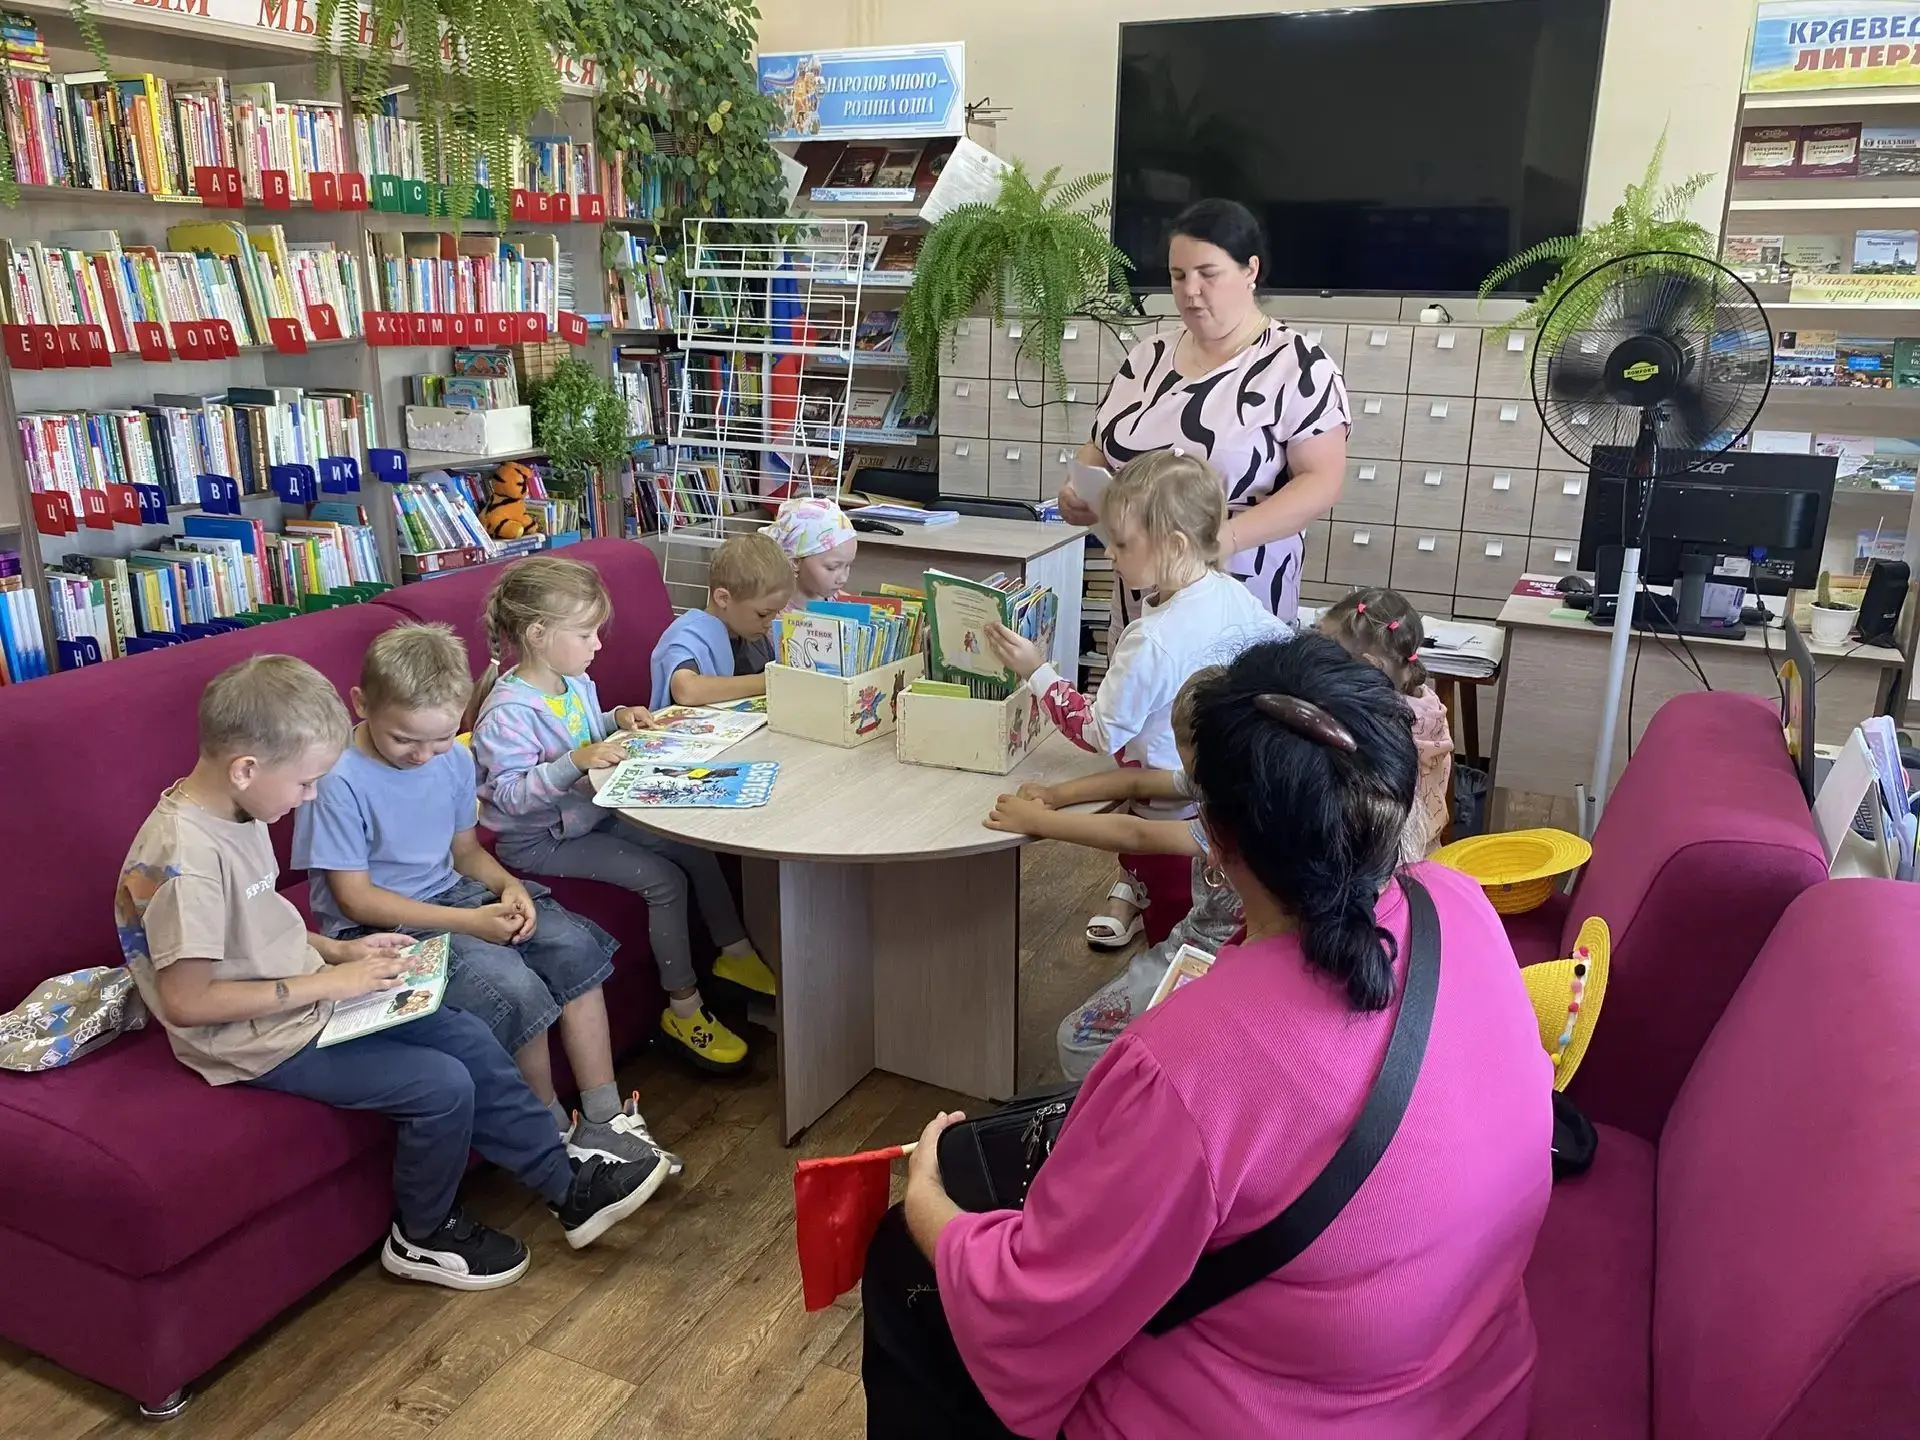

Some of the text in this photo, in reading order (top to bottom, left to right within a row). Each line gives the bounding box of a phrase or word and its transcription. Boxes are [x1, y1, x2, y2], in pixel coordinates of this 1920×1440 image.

[1789, 16, 1920, 44] КРАЕВЕД
[827, 75, 886, 94] НАРОДОВ
[843, 97, 935, 118] РОДИНА ОДНА
[213, 174, 220, 191] А
[228, 174, 236, 192] Б
[275, 177, 283, 194] В
[325, 180, 330, 195] Г
[382, 182, 393, 196] М
[352, 184, 361, 201] Д
[414, 186, 421, 200] С
[516, 194, 524, 207] А
[540, 198, 547, 210] Б
[560, 198, 566, 211] Г
[592, 201, 600, 215] Д
[1864, 277, 1915, 288] лучше
[1825, 288, 1864, 301] край
[321, 310, 329, 325] У
[527, 318, 537, 330] Ф
[219, 325, 229, 341] С
[287, 325, 296, 340] Т
[418, 319, 425, 332] Л
[432, 319, 442, 332] М
[455, 320, 463, 333] О
[475, 319, 483, 332] П
[499, 319, 506, 332] С
[572, 319, 583, 334] Ш
[21, 333, 30, 351] Е
[45, 332, 54, 349] З
[69, 333, 80, 350] К
[89, 331, 102, 348] М
[150, 329, 162, 347] Н
[188, 330, 197, 345] О
[204, 329, 215, 344] П
[393, 456, 401, 469] Л
[1686, 461, 1734, 474] acer
[332, 466, 341, 480] И
[343, 464, 353, 478] К
[211, 483, 220, 499] В
[226, 483, 232, 498] Г
[290, 477, 299, 496] Д
[58, 499, 69, 515] Ч
[90, 497, 105, 513] Ш
[124, 492, 133, 508] Я
[139, 492, 147, 508] А
[150, 492, 160, 508] Б
[47, 504, 57, 522] Ц
[807, 629, 833, 639] УТЁНОК
[74, 650, 83, 667] Н
[87, 644, 95, 660] О
